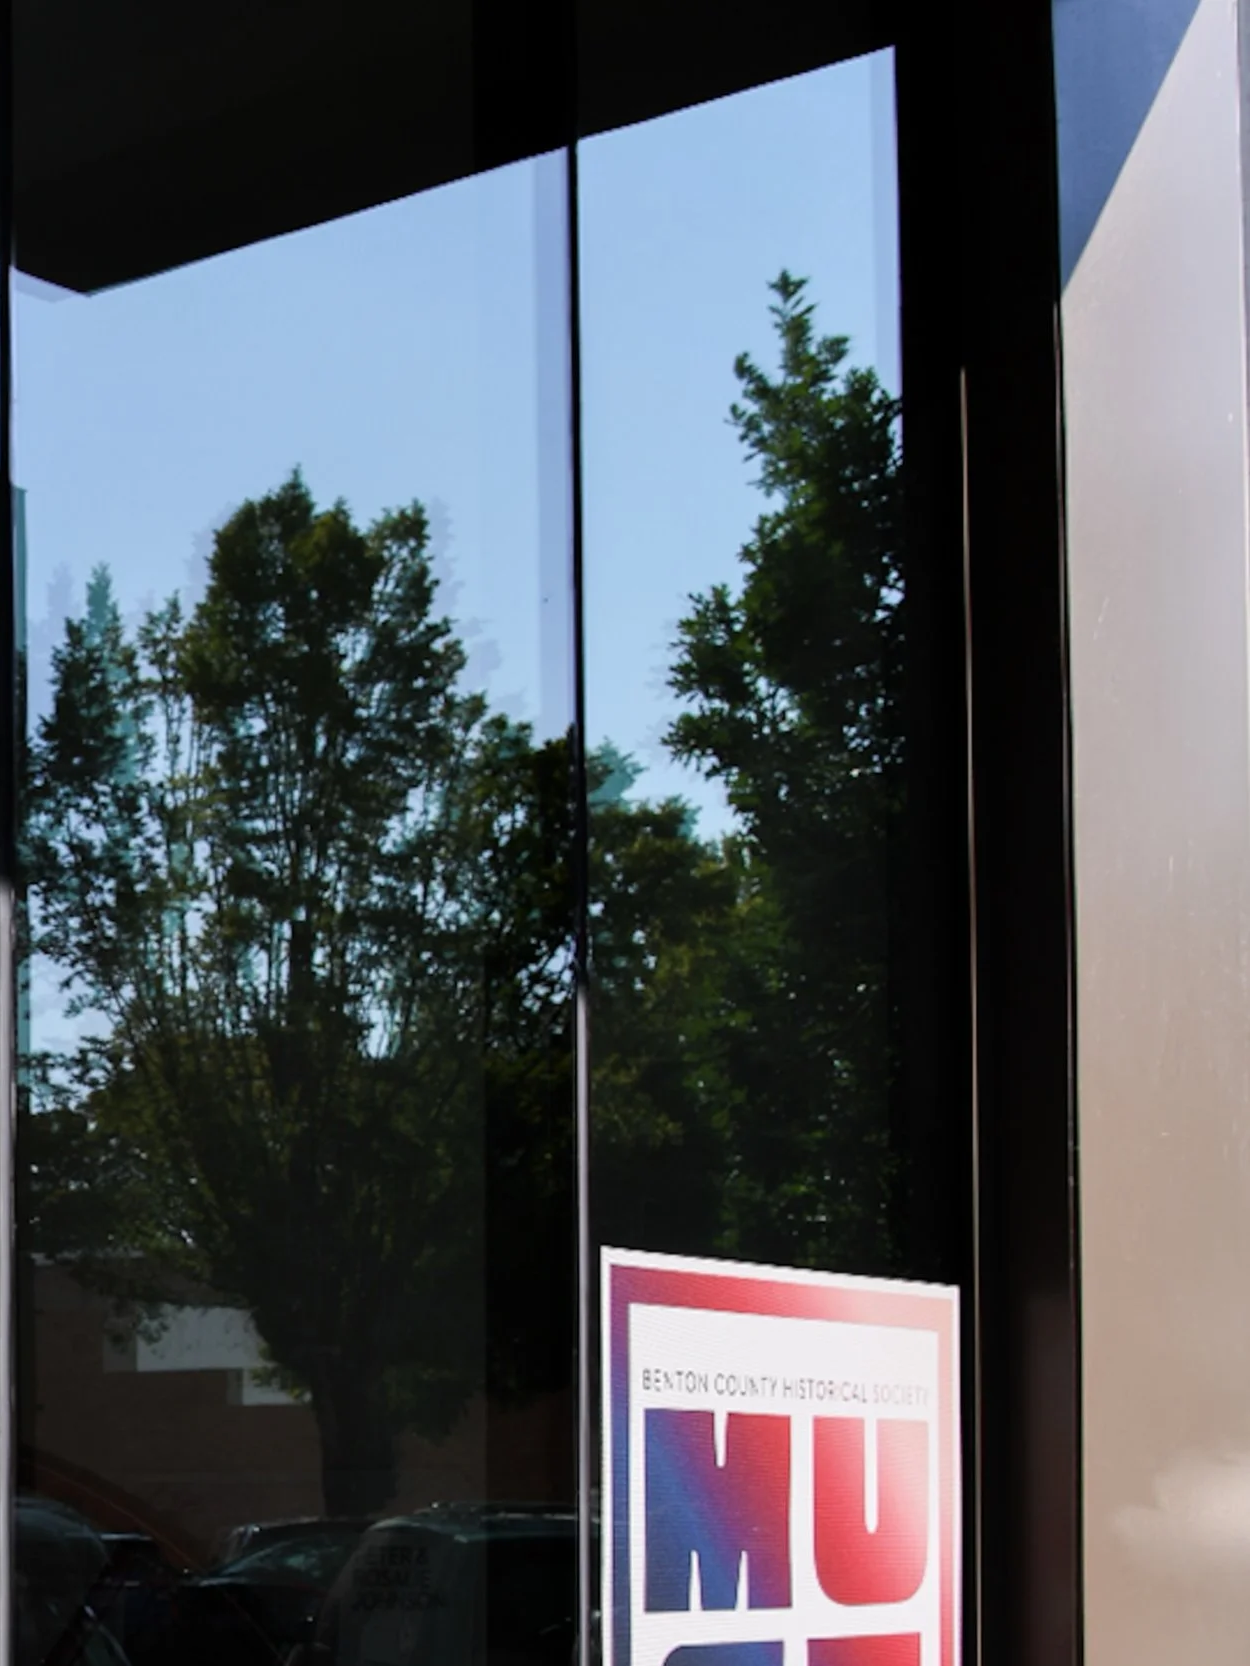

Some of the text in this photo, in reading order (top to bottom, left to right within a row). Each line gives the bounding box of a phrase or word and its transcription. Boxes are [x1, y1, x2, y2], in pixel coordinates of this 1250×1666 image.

[641, 1367, 930, 1406] BENTON COUNTY HISTORICAL SOCIETY
